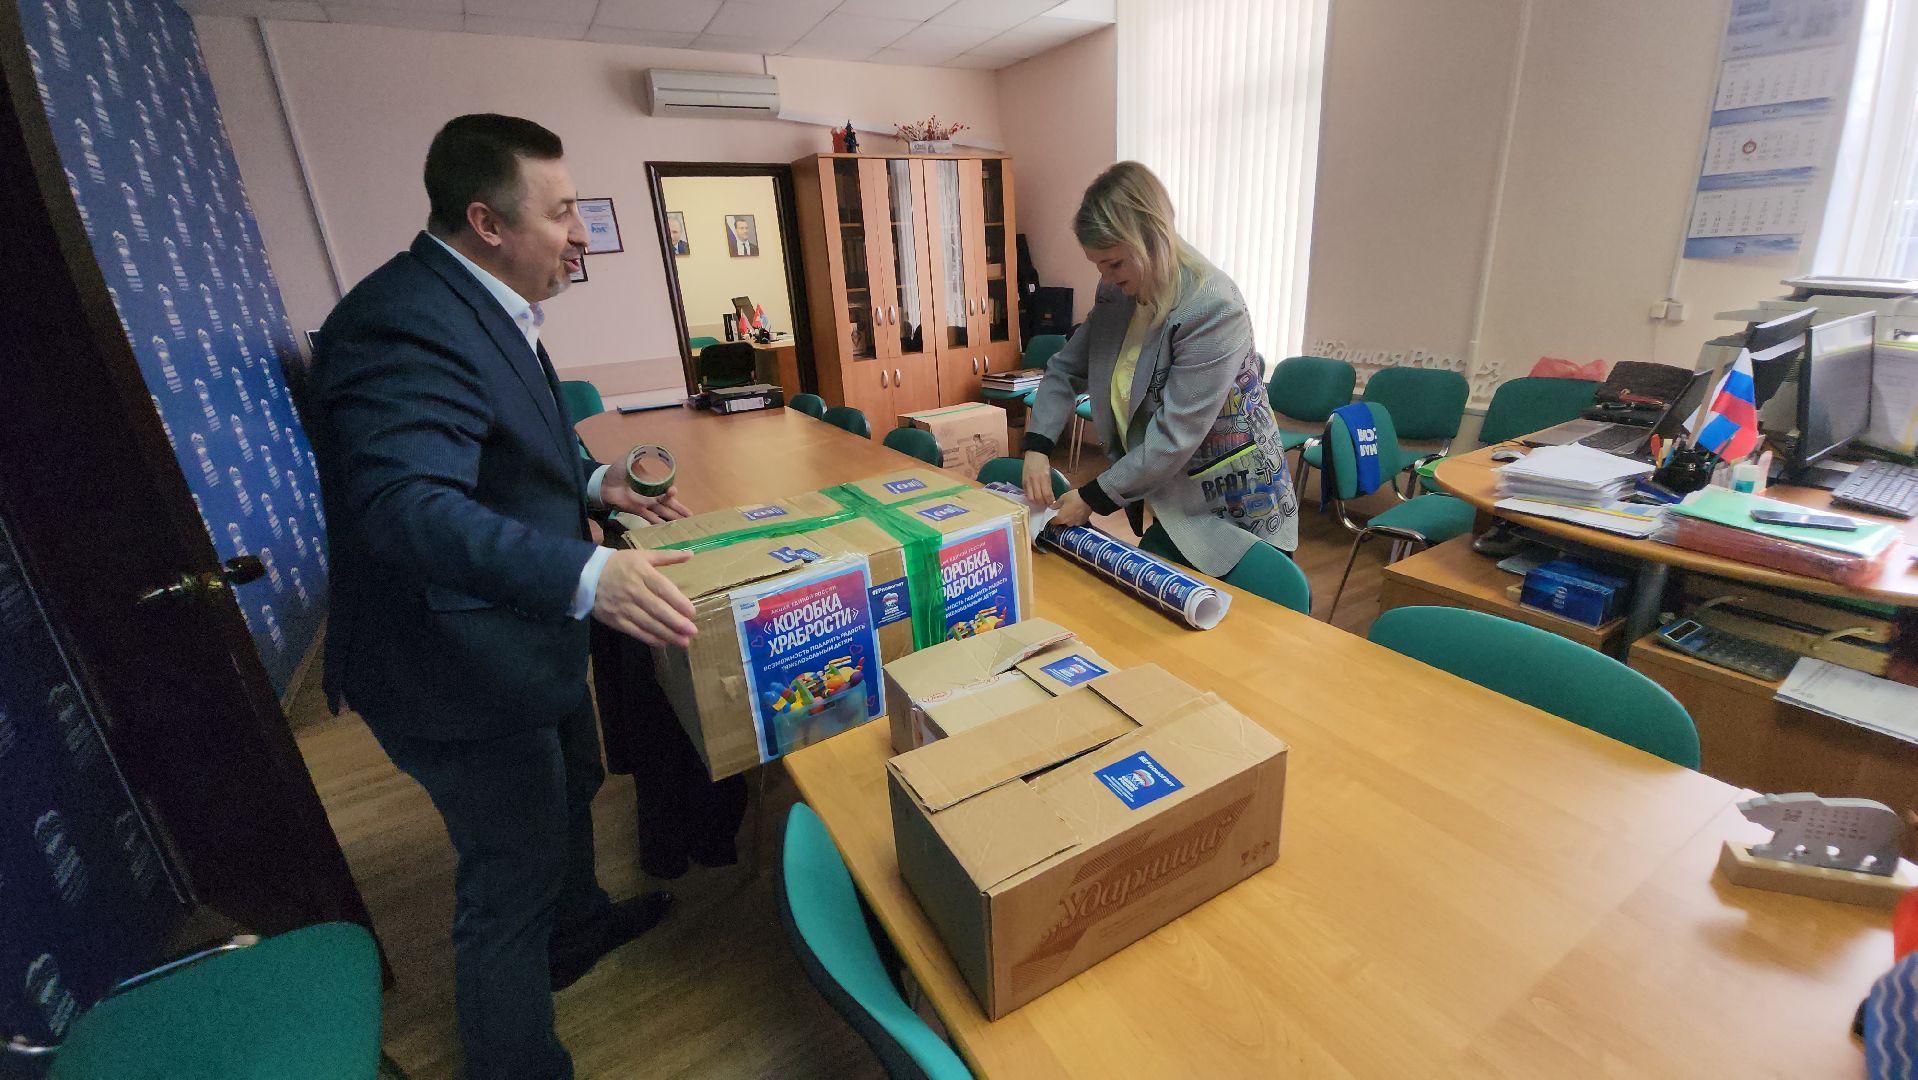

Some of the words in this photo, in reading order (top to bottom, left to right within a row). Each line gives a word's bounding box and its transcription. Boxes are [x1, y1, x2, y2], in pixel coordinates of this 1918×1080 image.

[763, 592, 843, 635] «КОРОБКА
[767, 607, 860, 658] ХРАБРОСТИ»
[809, 635, 841, 652] ПОДАРИТЬ
